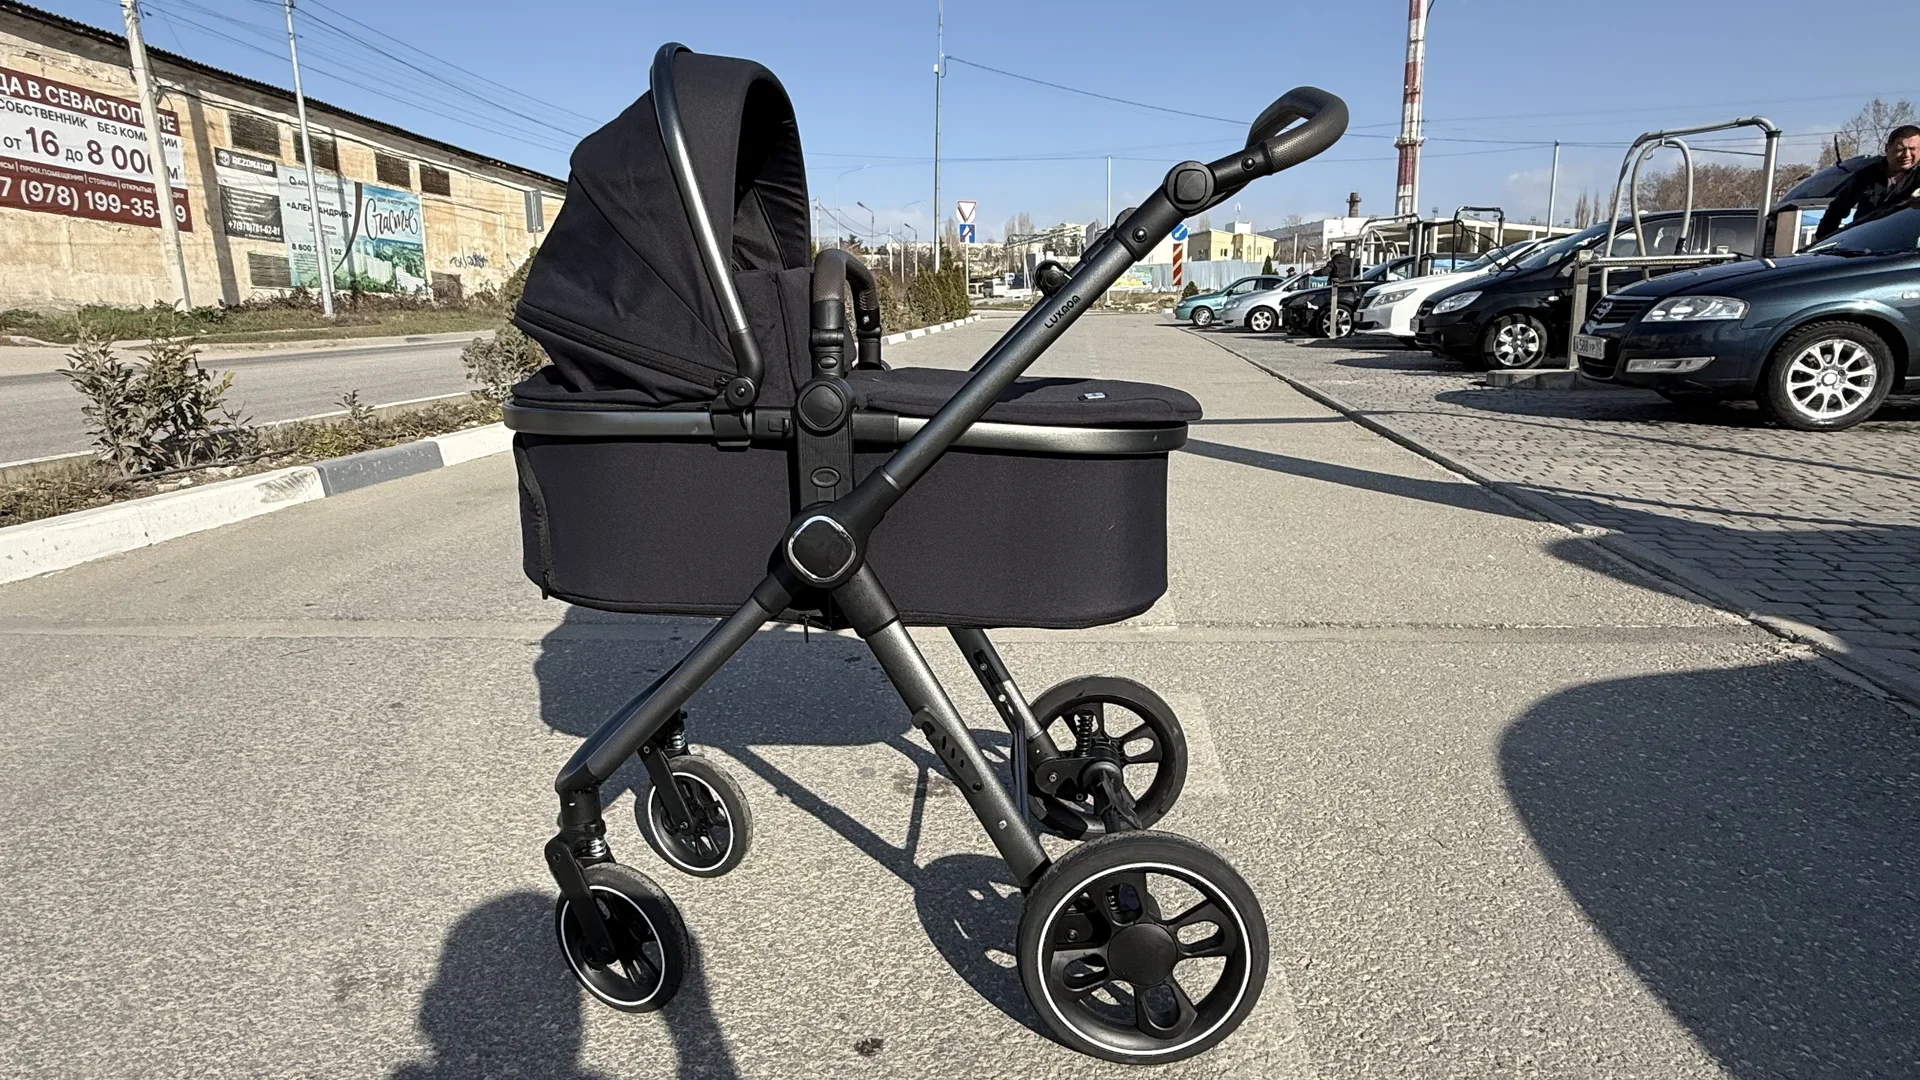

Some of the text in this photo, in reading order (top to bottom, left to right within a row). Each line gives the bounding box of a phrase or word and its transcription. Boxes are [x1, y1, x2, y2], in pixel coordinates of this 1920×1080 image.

[0, 98, 88, 130] СОБСТВЕННИК
[97, 121, 118, 136] БЕЗ
[27, 80, 42, 99] В
[45, 85, 177, 132] СЕВАСТОПЛЕ
[25, 126, 60, 157] 16
[86, 139, 104, 165] 8
[20, 179, 79, 211] (978)
[84, 190, 187, 223] 199-35-9
